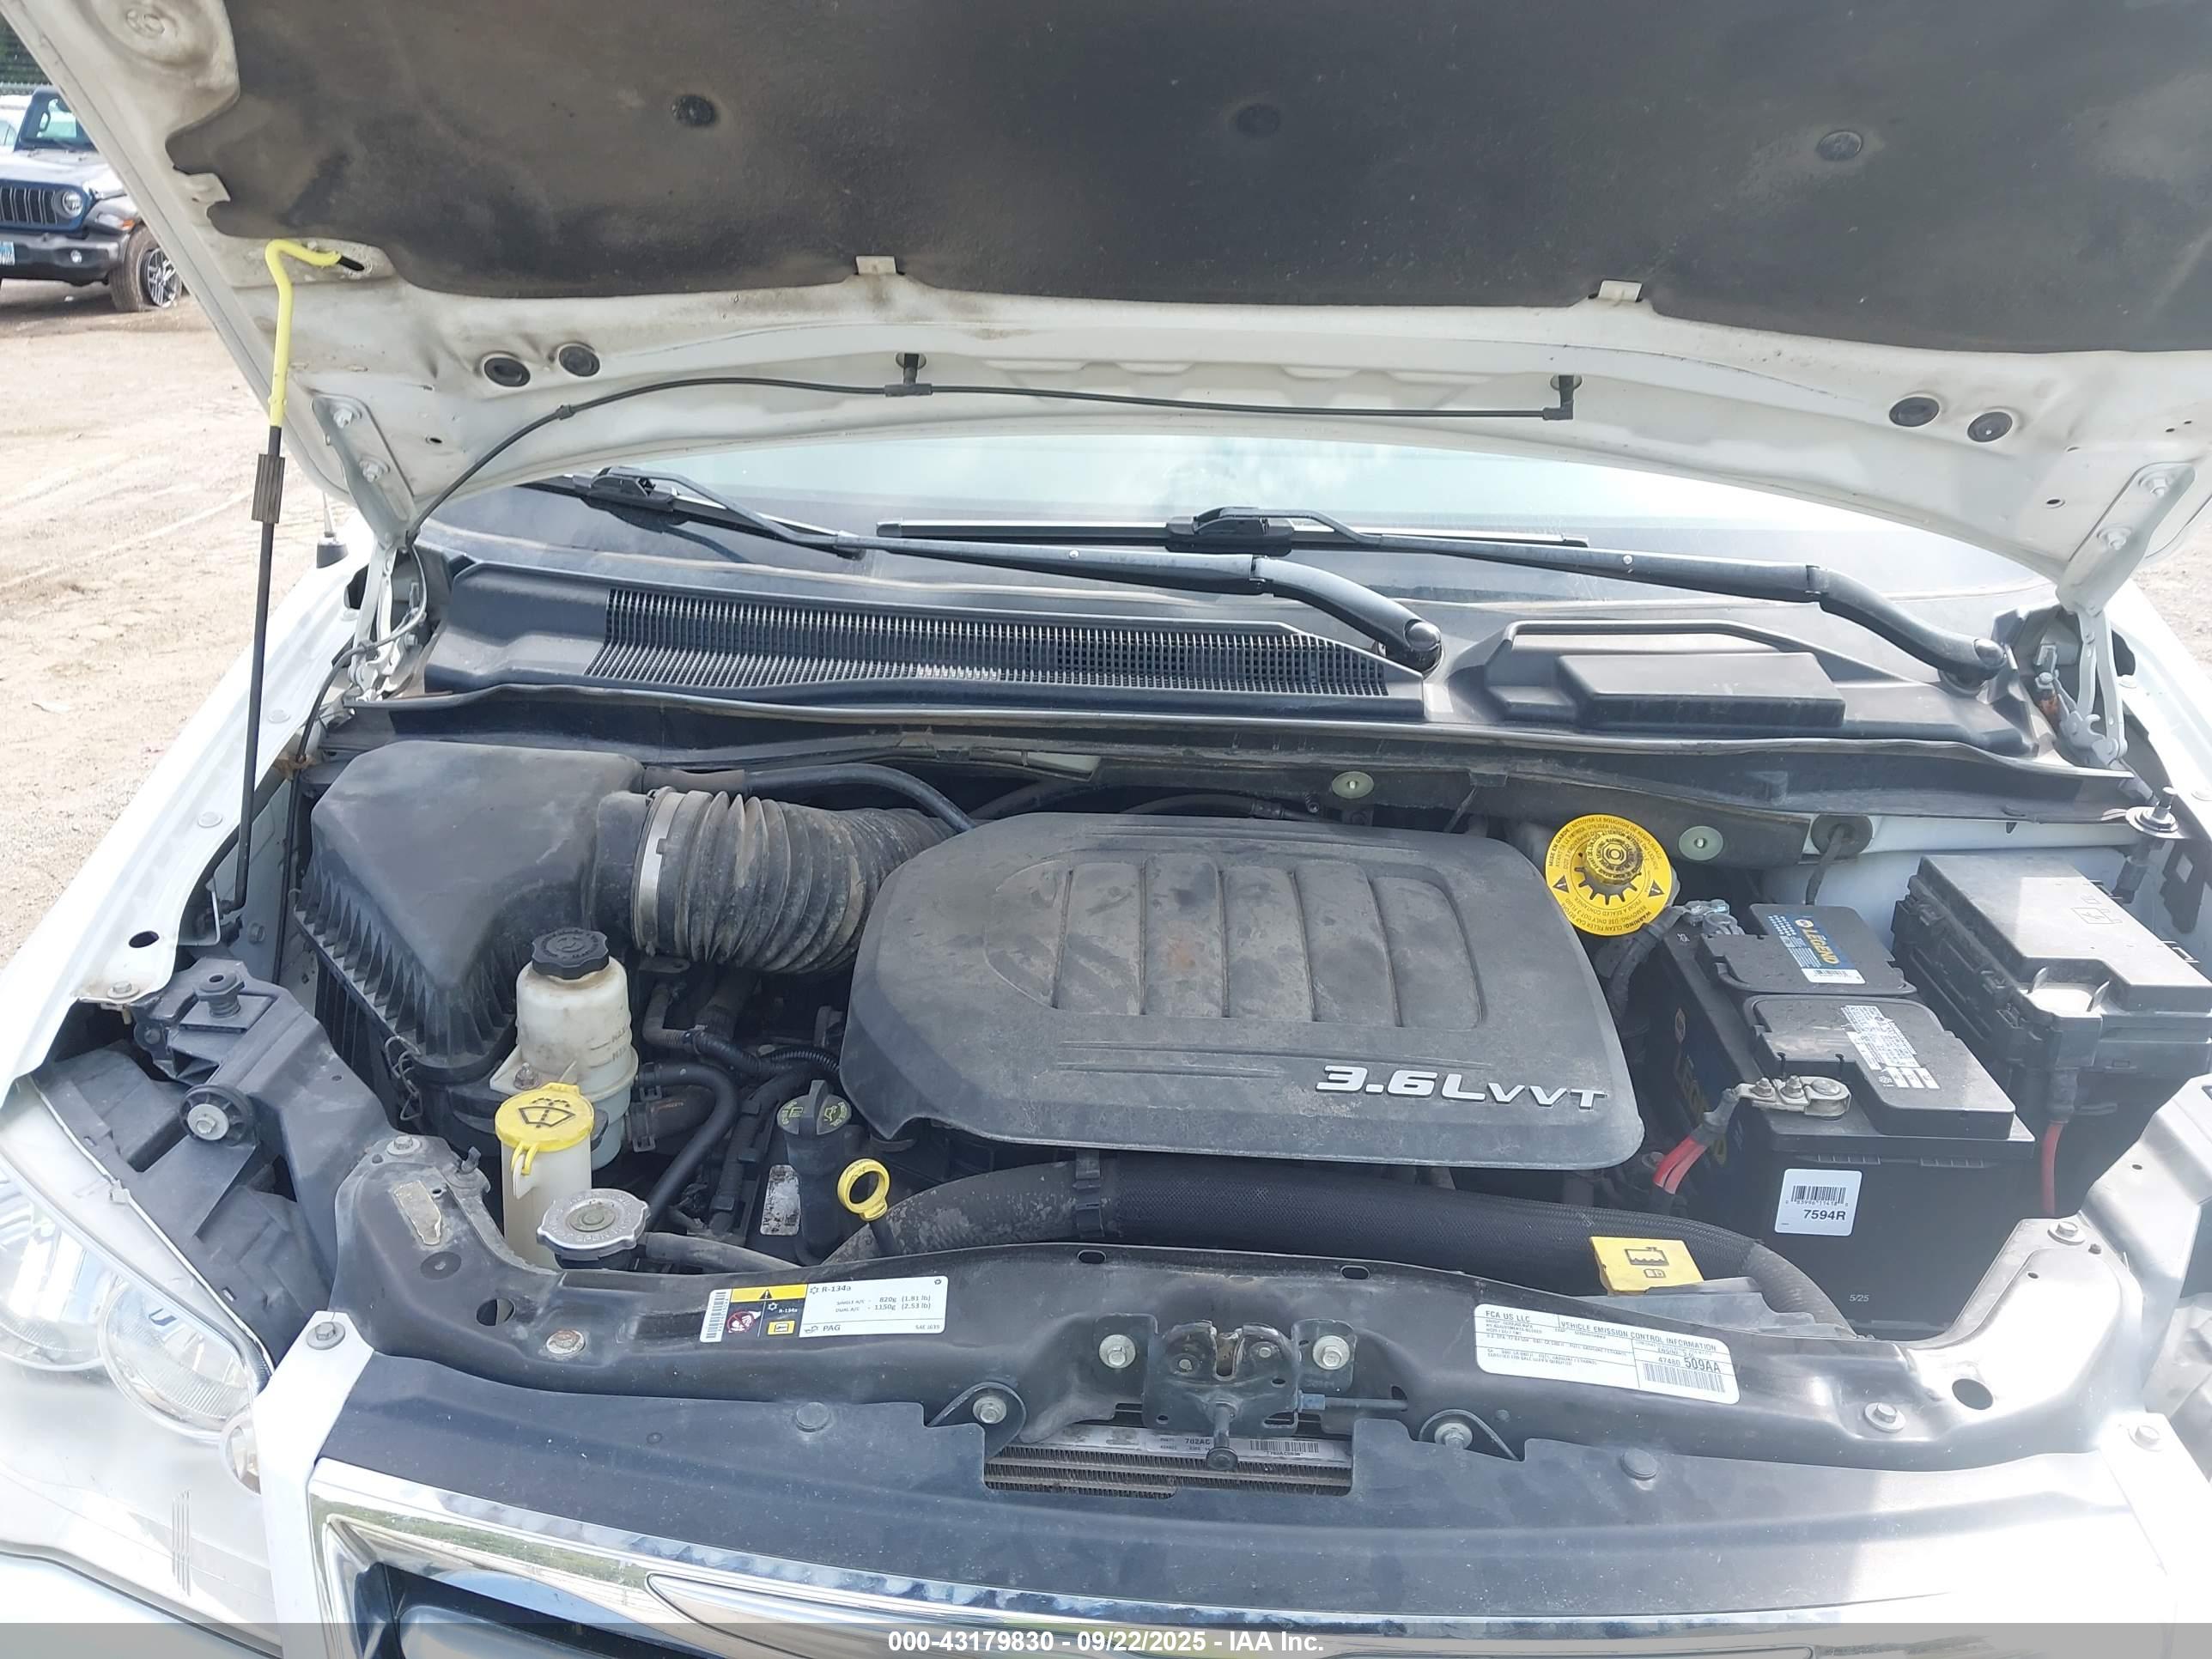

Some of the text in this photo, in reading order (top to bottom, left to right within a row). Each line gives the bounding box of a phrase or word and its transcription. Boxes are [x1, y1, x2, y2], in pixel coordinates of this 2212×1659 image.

[1803, 1208, 1846, 1221] 7594R
[1849, 1294, 1869, 1303] 5/25
[1485, 1310, 1501, 1319] FCA
[1503, 1312, 1514, 1321] US
[1561, 1321, 1591, 1331] VEHICLE
[1593, 1326, 1629, 1338] EMISSION
[1630, 1332, 1662, 1343] CONTROL
[1666, 1337, 1717, 1352] INFORMATION
[1683, 1357, 1722, 1374] 509AA
